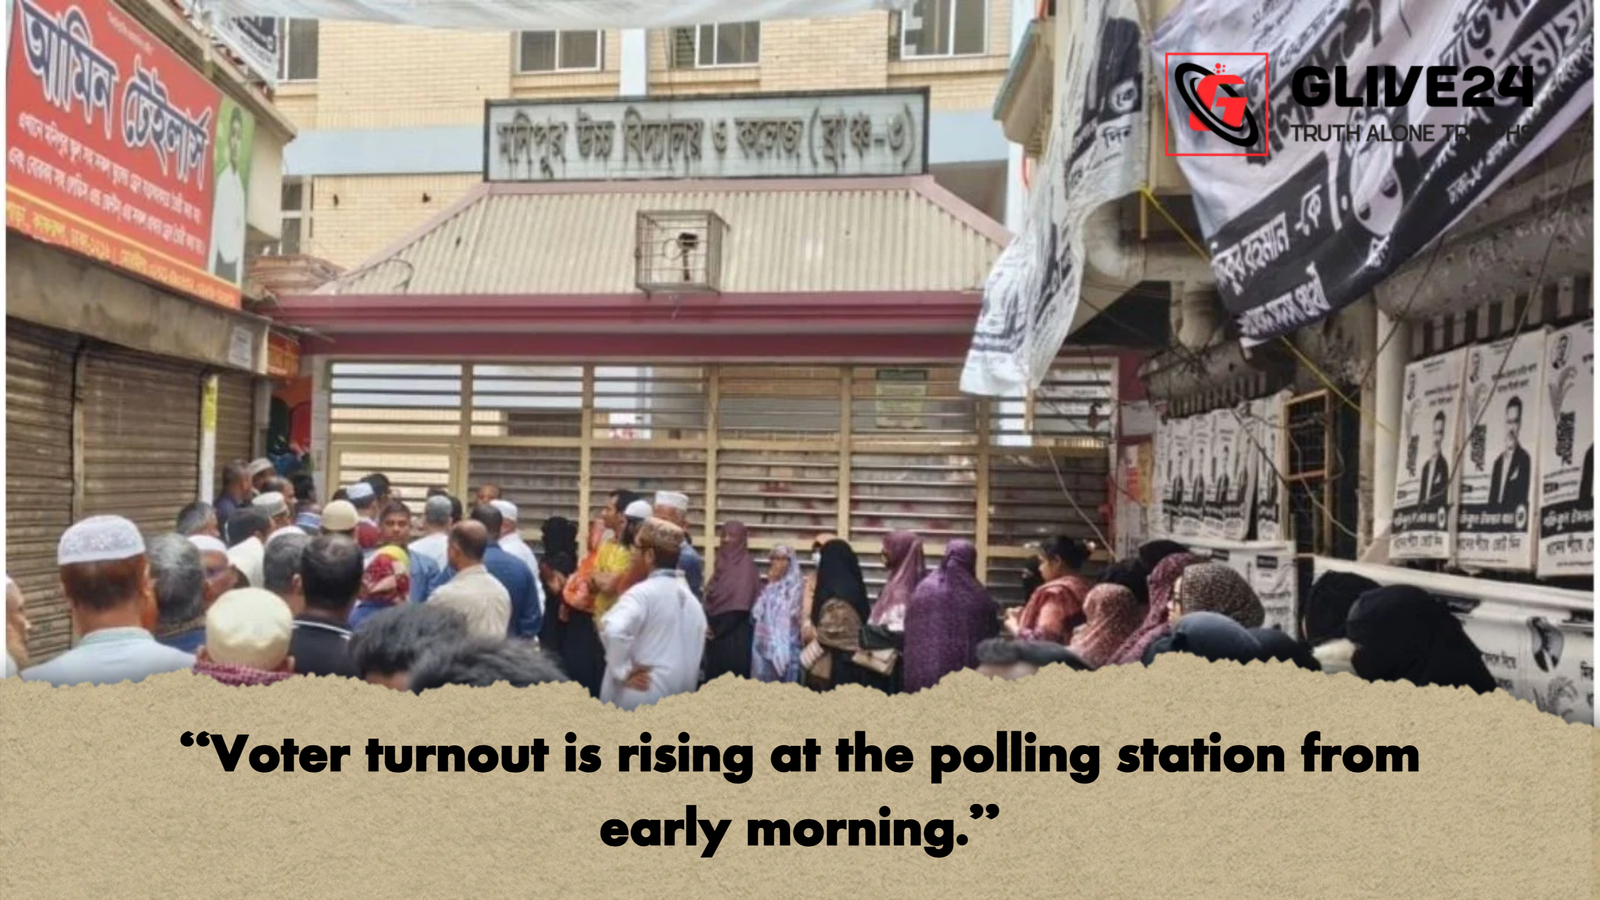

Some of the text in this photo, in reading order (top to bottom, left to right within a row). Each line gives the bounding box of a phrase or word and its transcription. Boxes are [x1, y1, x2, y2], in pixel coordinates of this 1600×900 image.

[20, 0, 214, 191] আমিন টেইলার্স
[575, 106, 617, 159] উচ্চ
[622, 105, 704, 164] বিদ্যালয়
[711, 116, 728, 154] ও
[734, 116, 804, 160] কলেজ
[1241, 211, 1290, 277] রহমান
